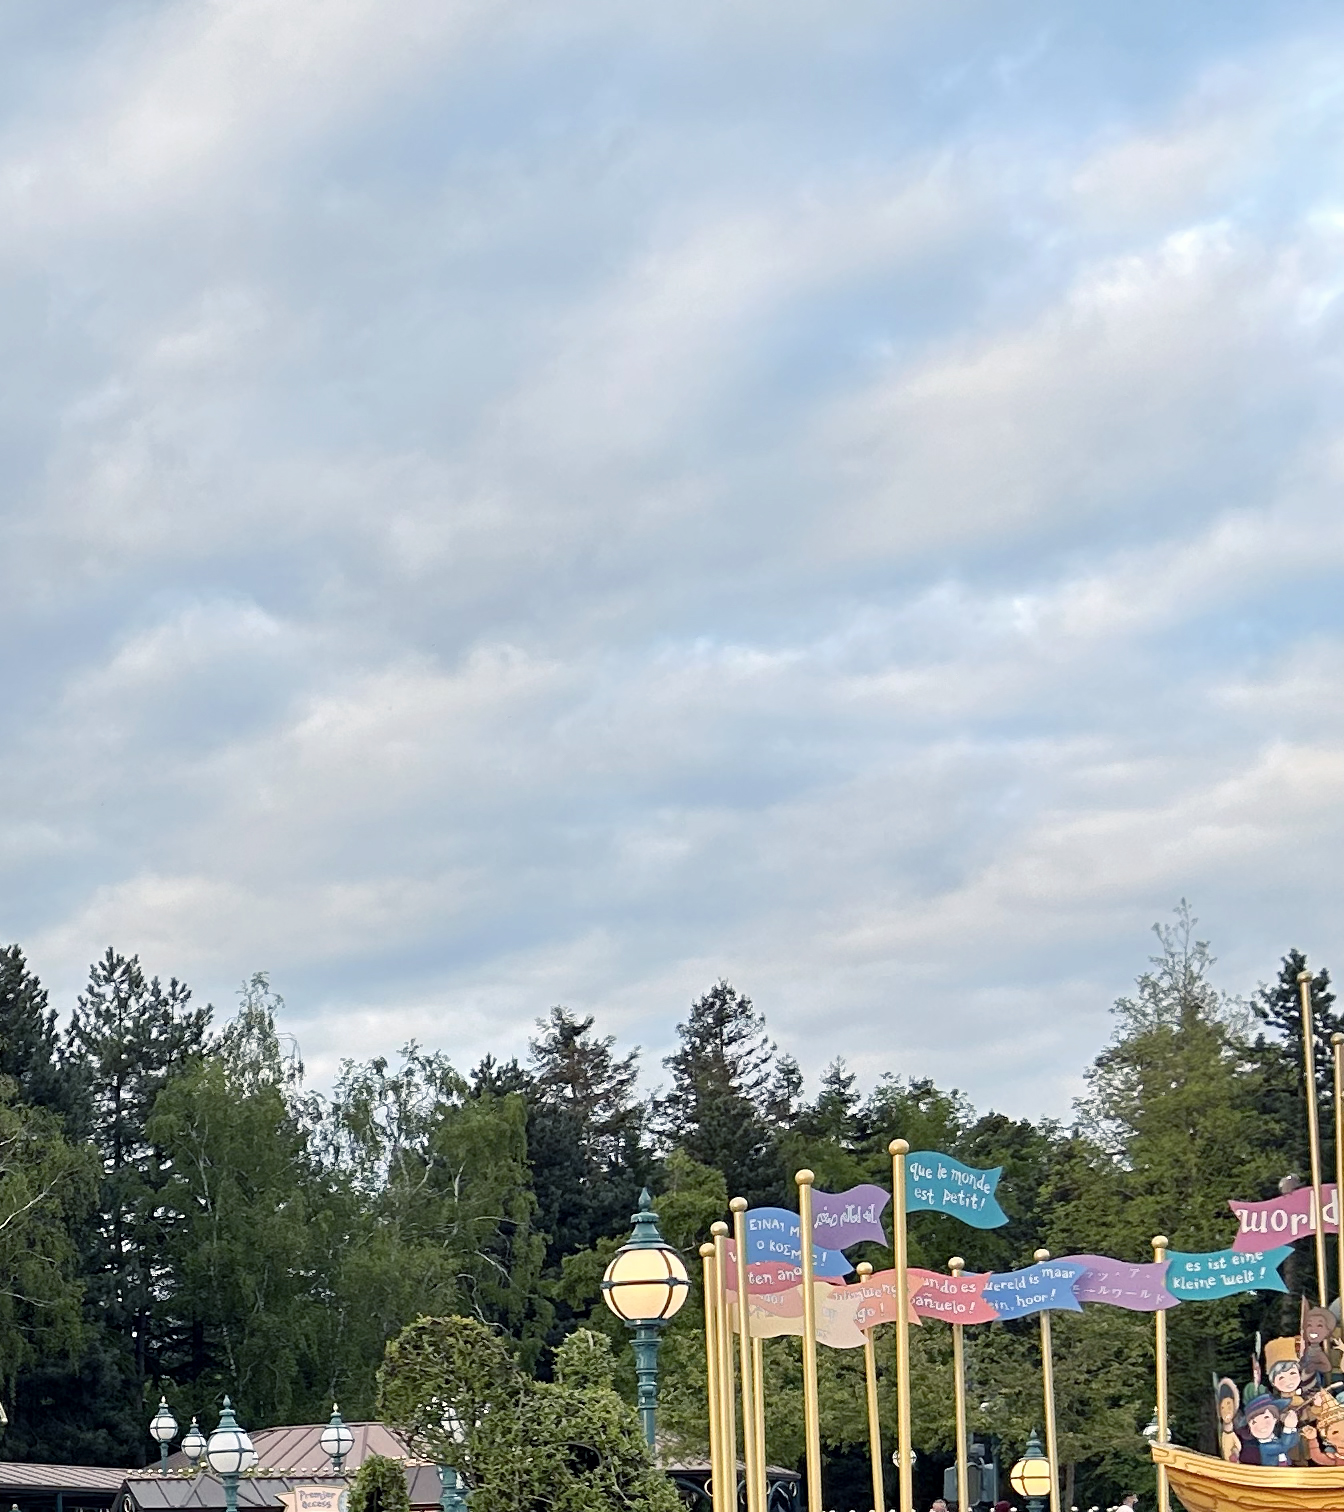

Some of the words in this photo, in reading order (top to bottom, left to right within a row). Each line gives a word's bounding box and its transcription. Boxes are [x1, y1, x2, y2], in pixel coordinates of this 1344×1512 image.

[910, 1162, 932, 1181] que
[937, 1163, 947, 1180] le
[951, 1169, 990, 1194] monde
[914, 1188, 934, 1205] est
[943, 1189, 986, 1211] petit!
[1186, 1262, 1201, 1272] es
[1208, 1257, 1227, 1270] ist
[1231, 1251, 1264, 1265] eine
[923, 1278, 958, 1294] undo
[961, 1283, 976, 1293] es
[1029, 1273, 1039, 1285] is
[1041, 1268, 1075, 1279] maar
